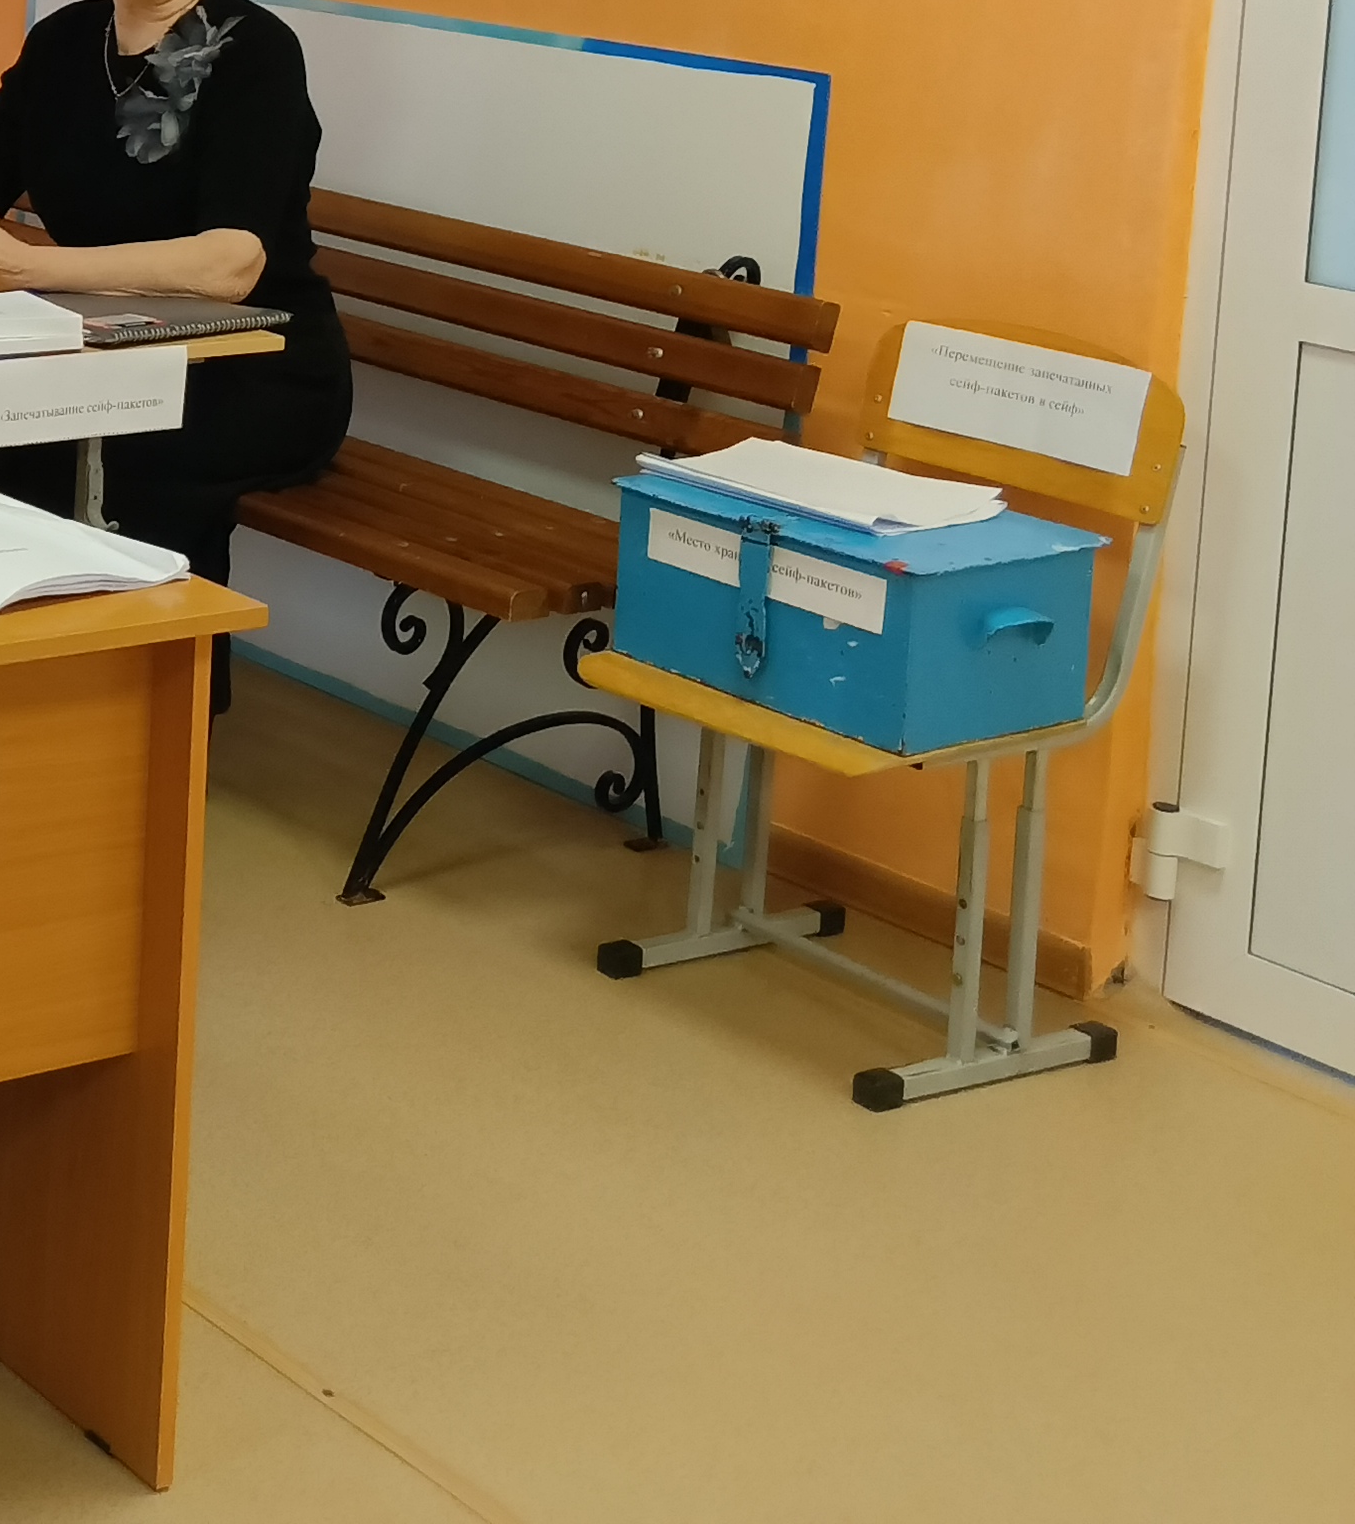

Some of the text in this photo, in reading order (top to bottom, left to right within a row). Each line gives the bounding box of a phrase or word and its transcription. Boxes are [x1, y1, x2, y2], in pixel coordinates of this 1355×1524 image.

[949, 377, 1035, 405] сейф-пакетов
[1029, 367, 1113, 395] запечатанных
[86, 398, 164, 414] сейф-пакетов»
[668, 528, 711, 552] «Место
[770, 562, 863, 600] сейф-пакетов»
